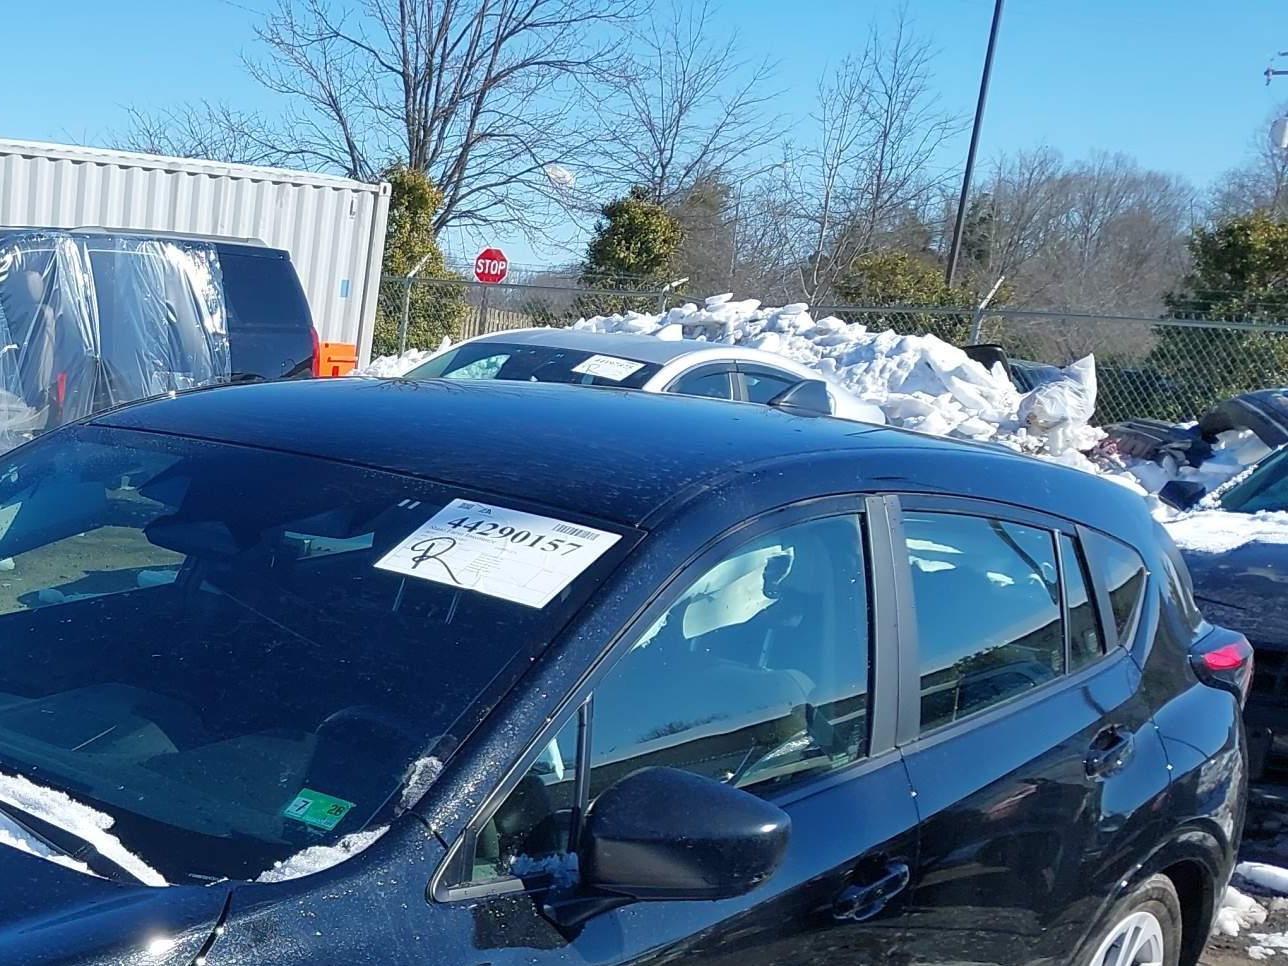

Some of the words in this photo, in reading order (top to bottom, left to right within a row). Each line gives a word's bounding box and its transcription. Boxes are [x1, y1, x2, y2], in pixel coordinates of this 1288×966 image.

[476, 259, 507, 275] STOP
[447, 516, 584, 557] 44290157
[295, 799, 310, 812] 7
